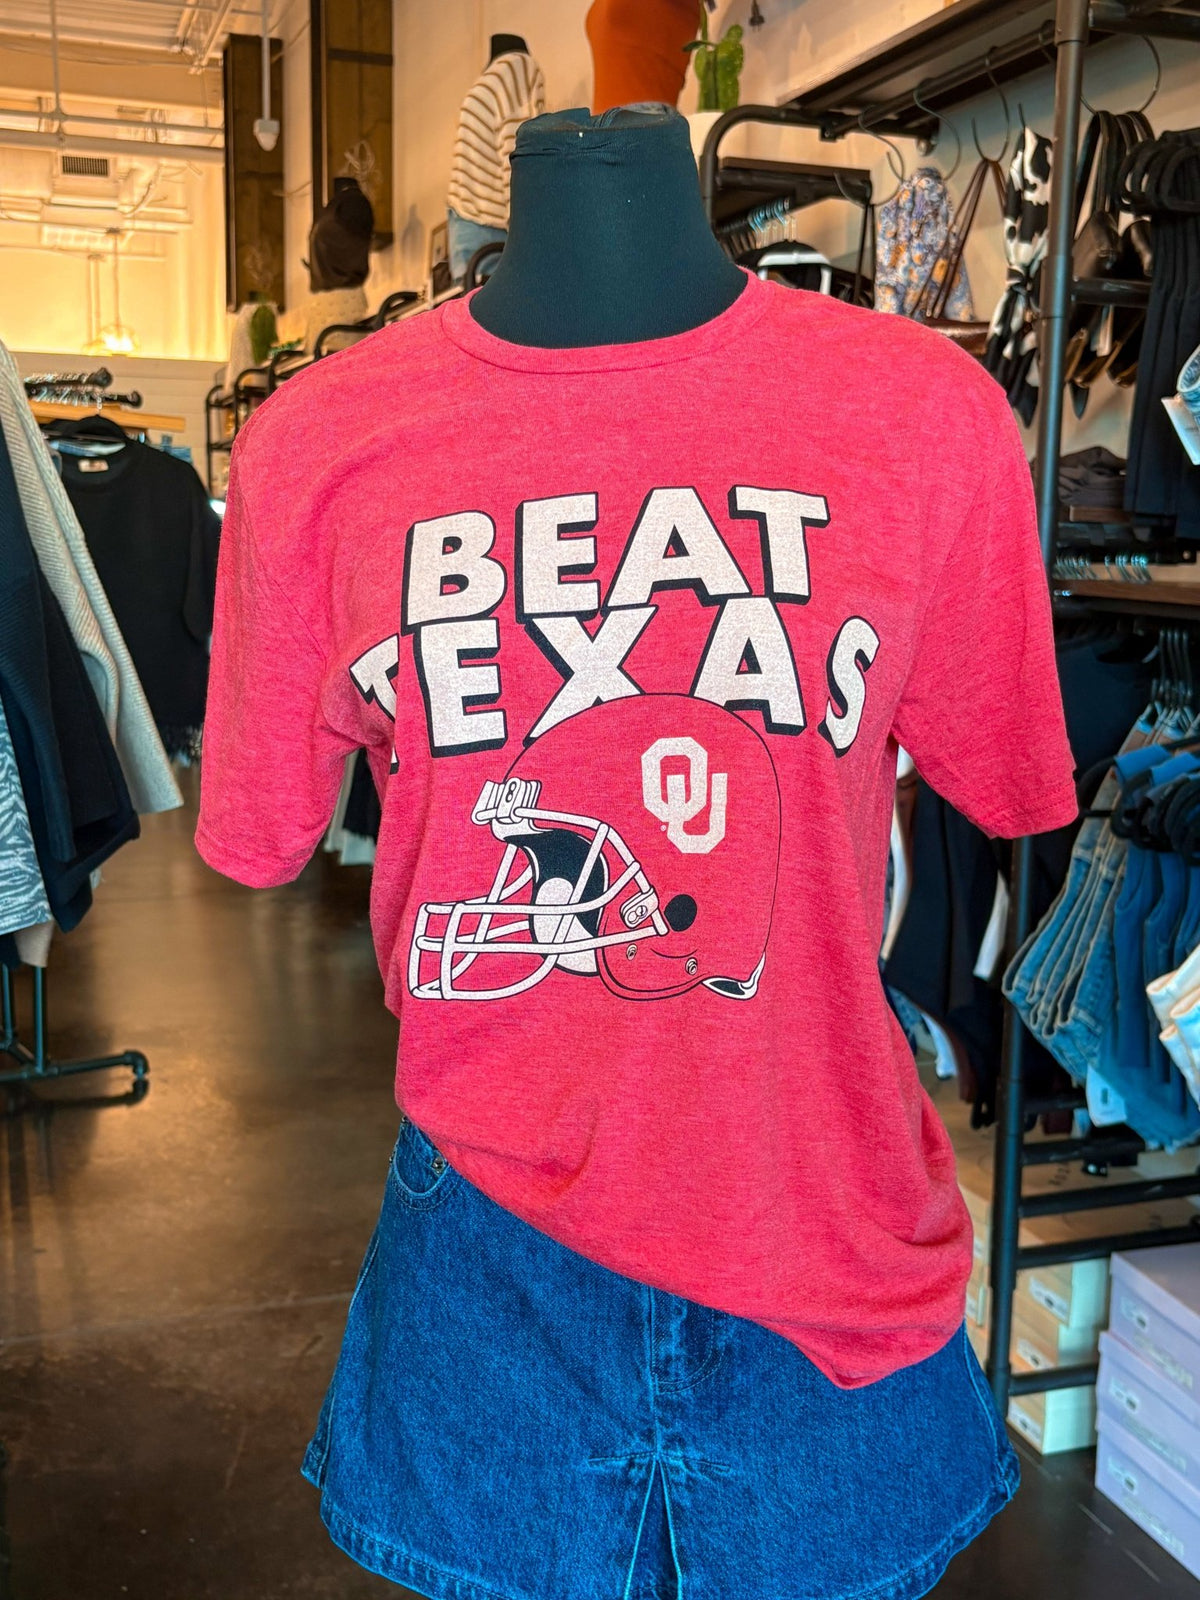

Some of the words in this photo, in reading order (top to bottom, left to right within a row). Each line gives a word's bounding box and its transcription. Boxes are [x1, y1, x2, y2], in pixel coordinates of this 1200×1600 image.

[401, 486, 830, 635] BEAT
[349, 597, 880, 773] TEXAS
[641, 736, 728, 854] OU
